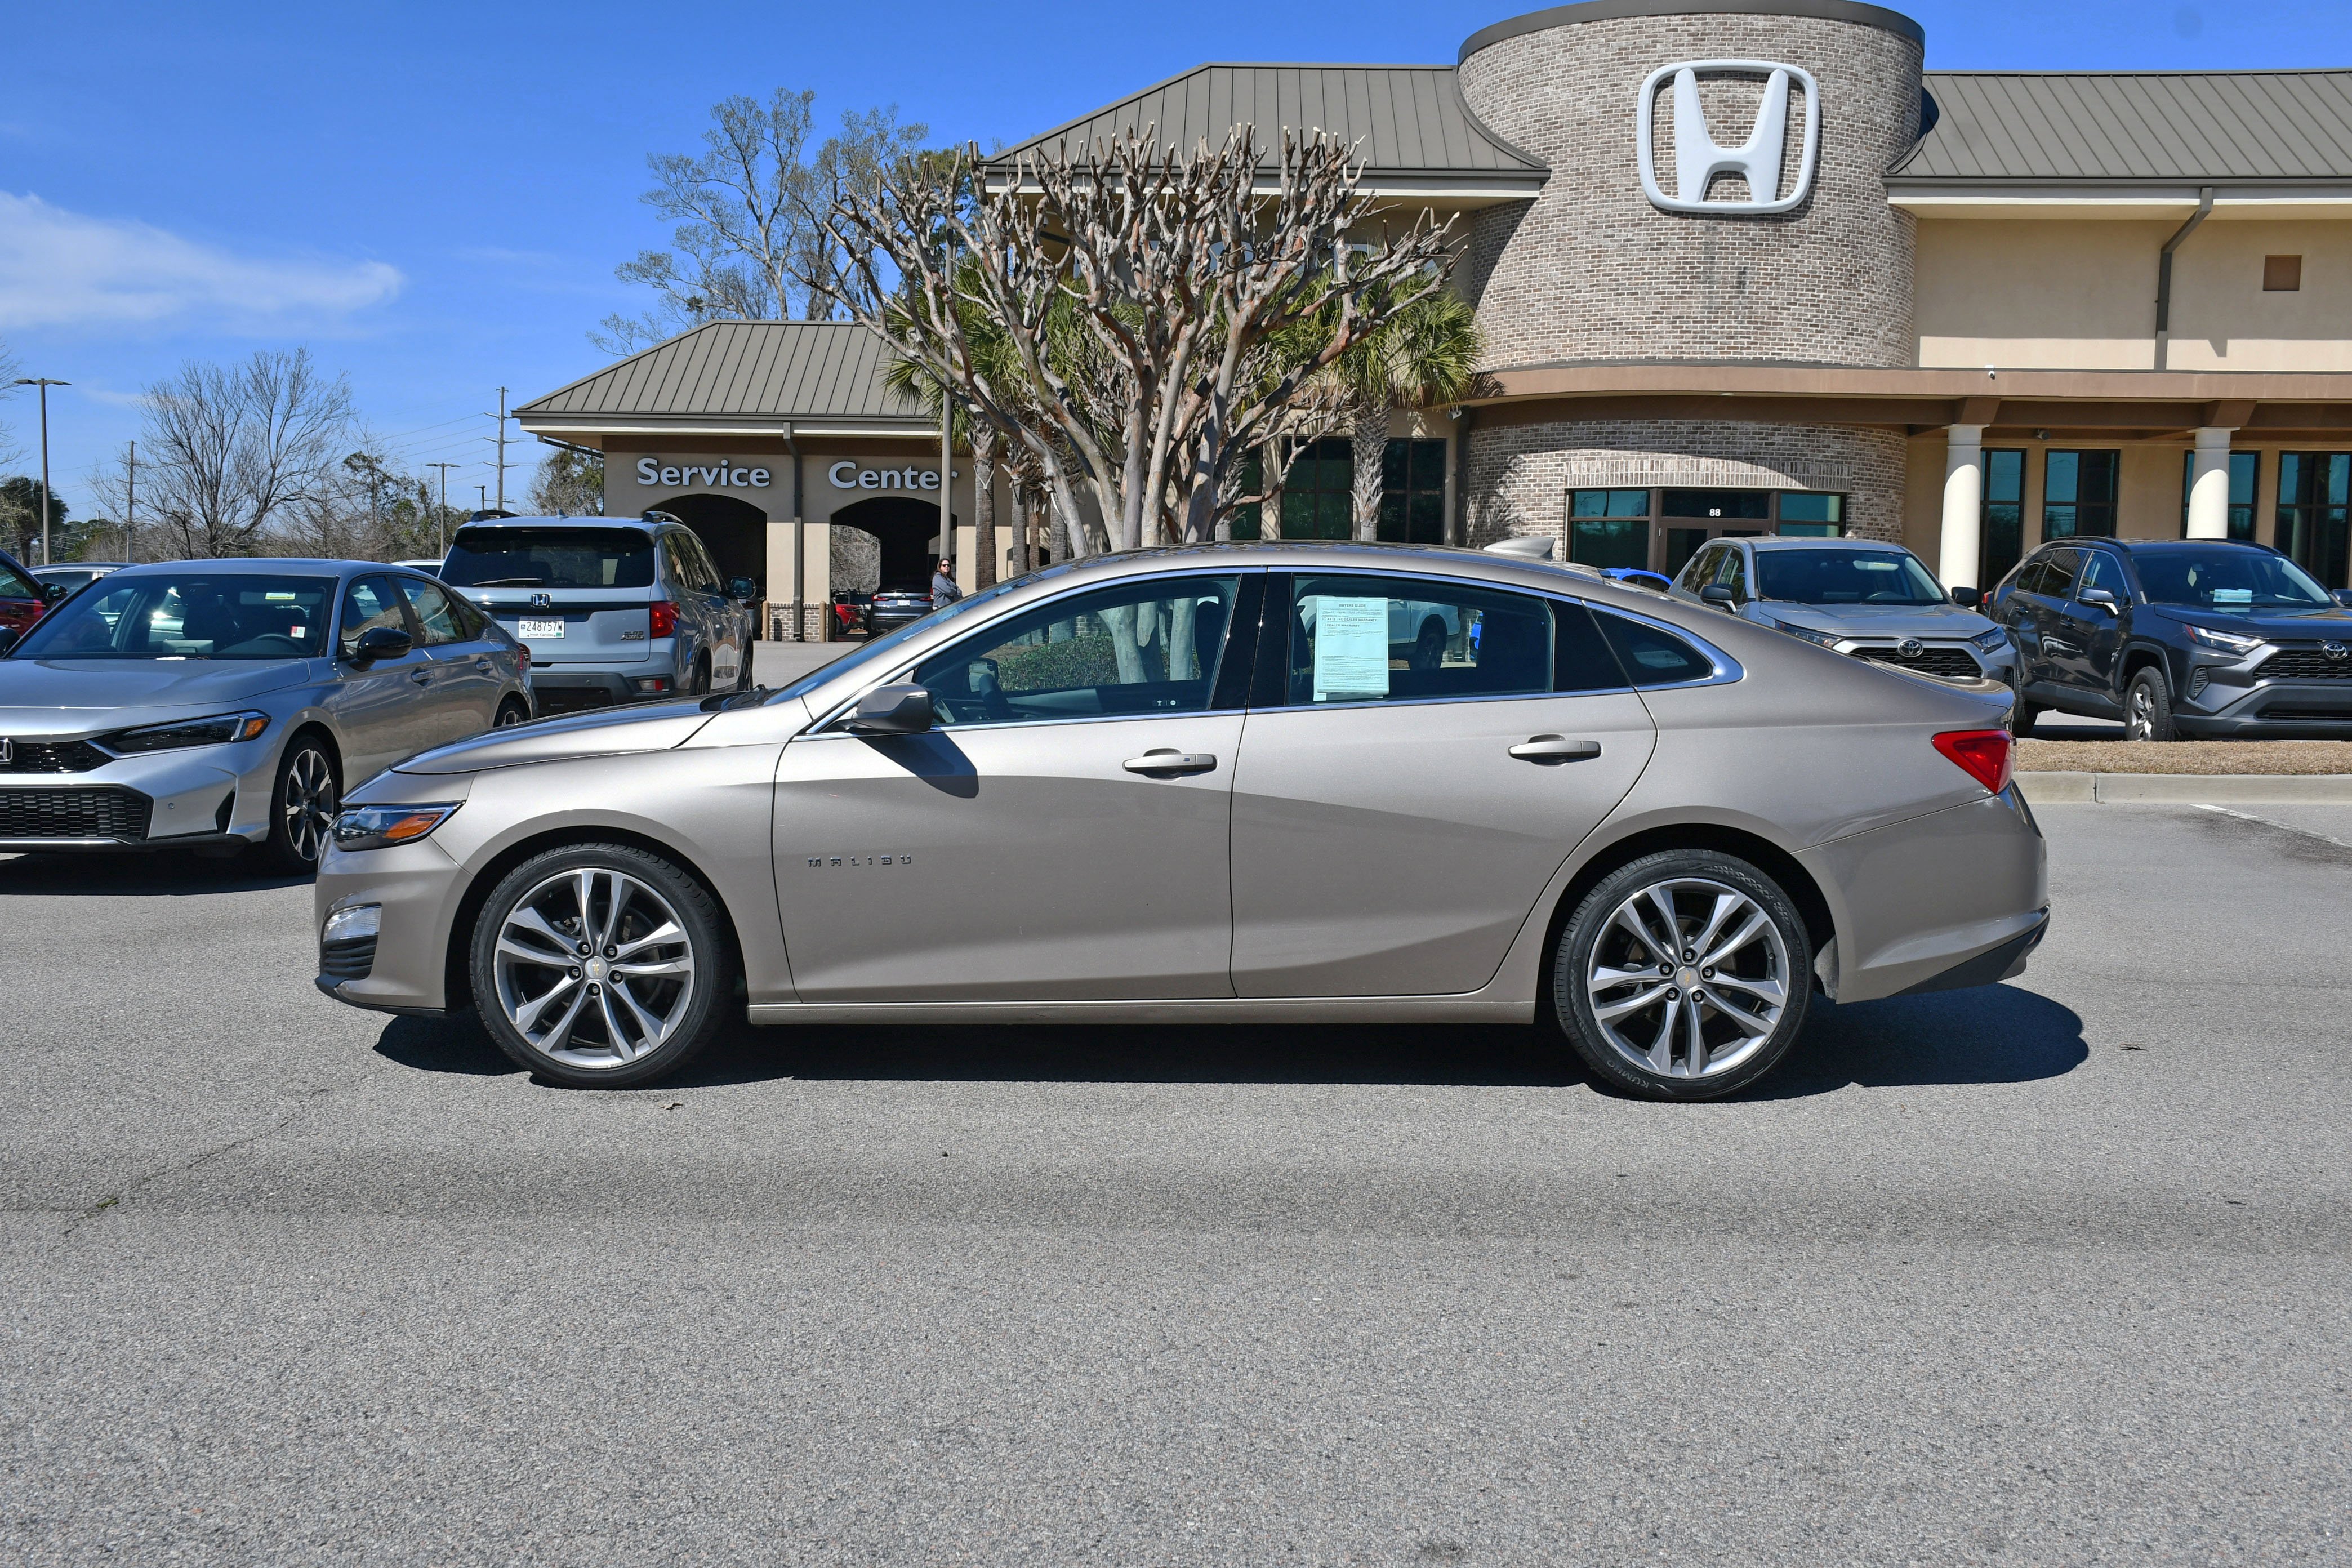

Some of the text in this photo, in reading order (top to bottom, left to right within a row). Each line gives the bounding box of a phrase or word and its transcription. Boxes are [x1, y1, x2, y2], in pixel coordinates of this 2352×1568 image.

[636, 457, 770, 487] Service
[1709, 508, 1721, 516] 88
[527, 621, 563, 631] 248757W
[808, 854, 911, 867] MALIBU
[1607, 1060, 1649, 1088] KUMHO
